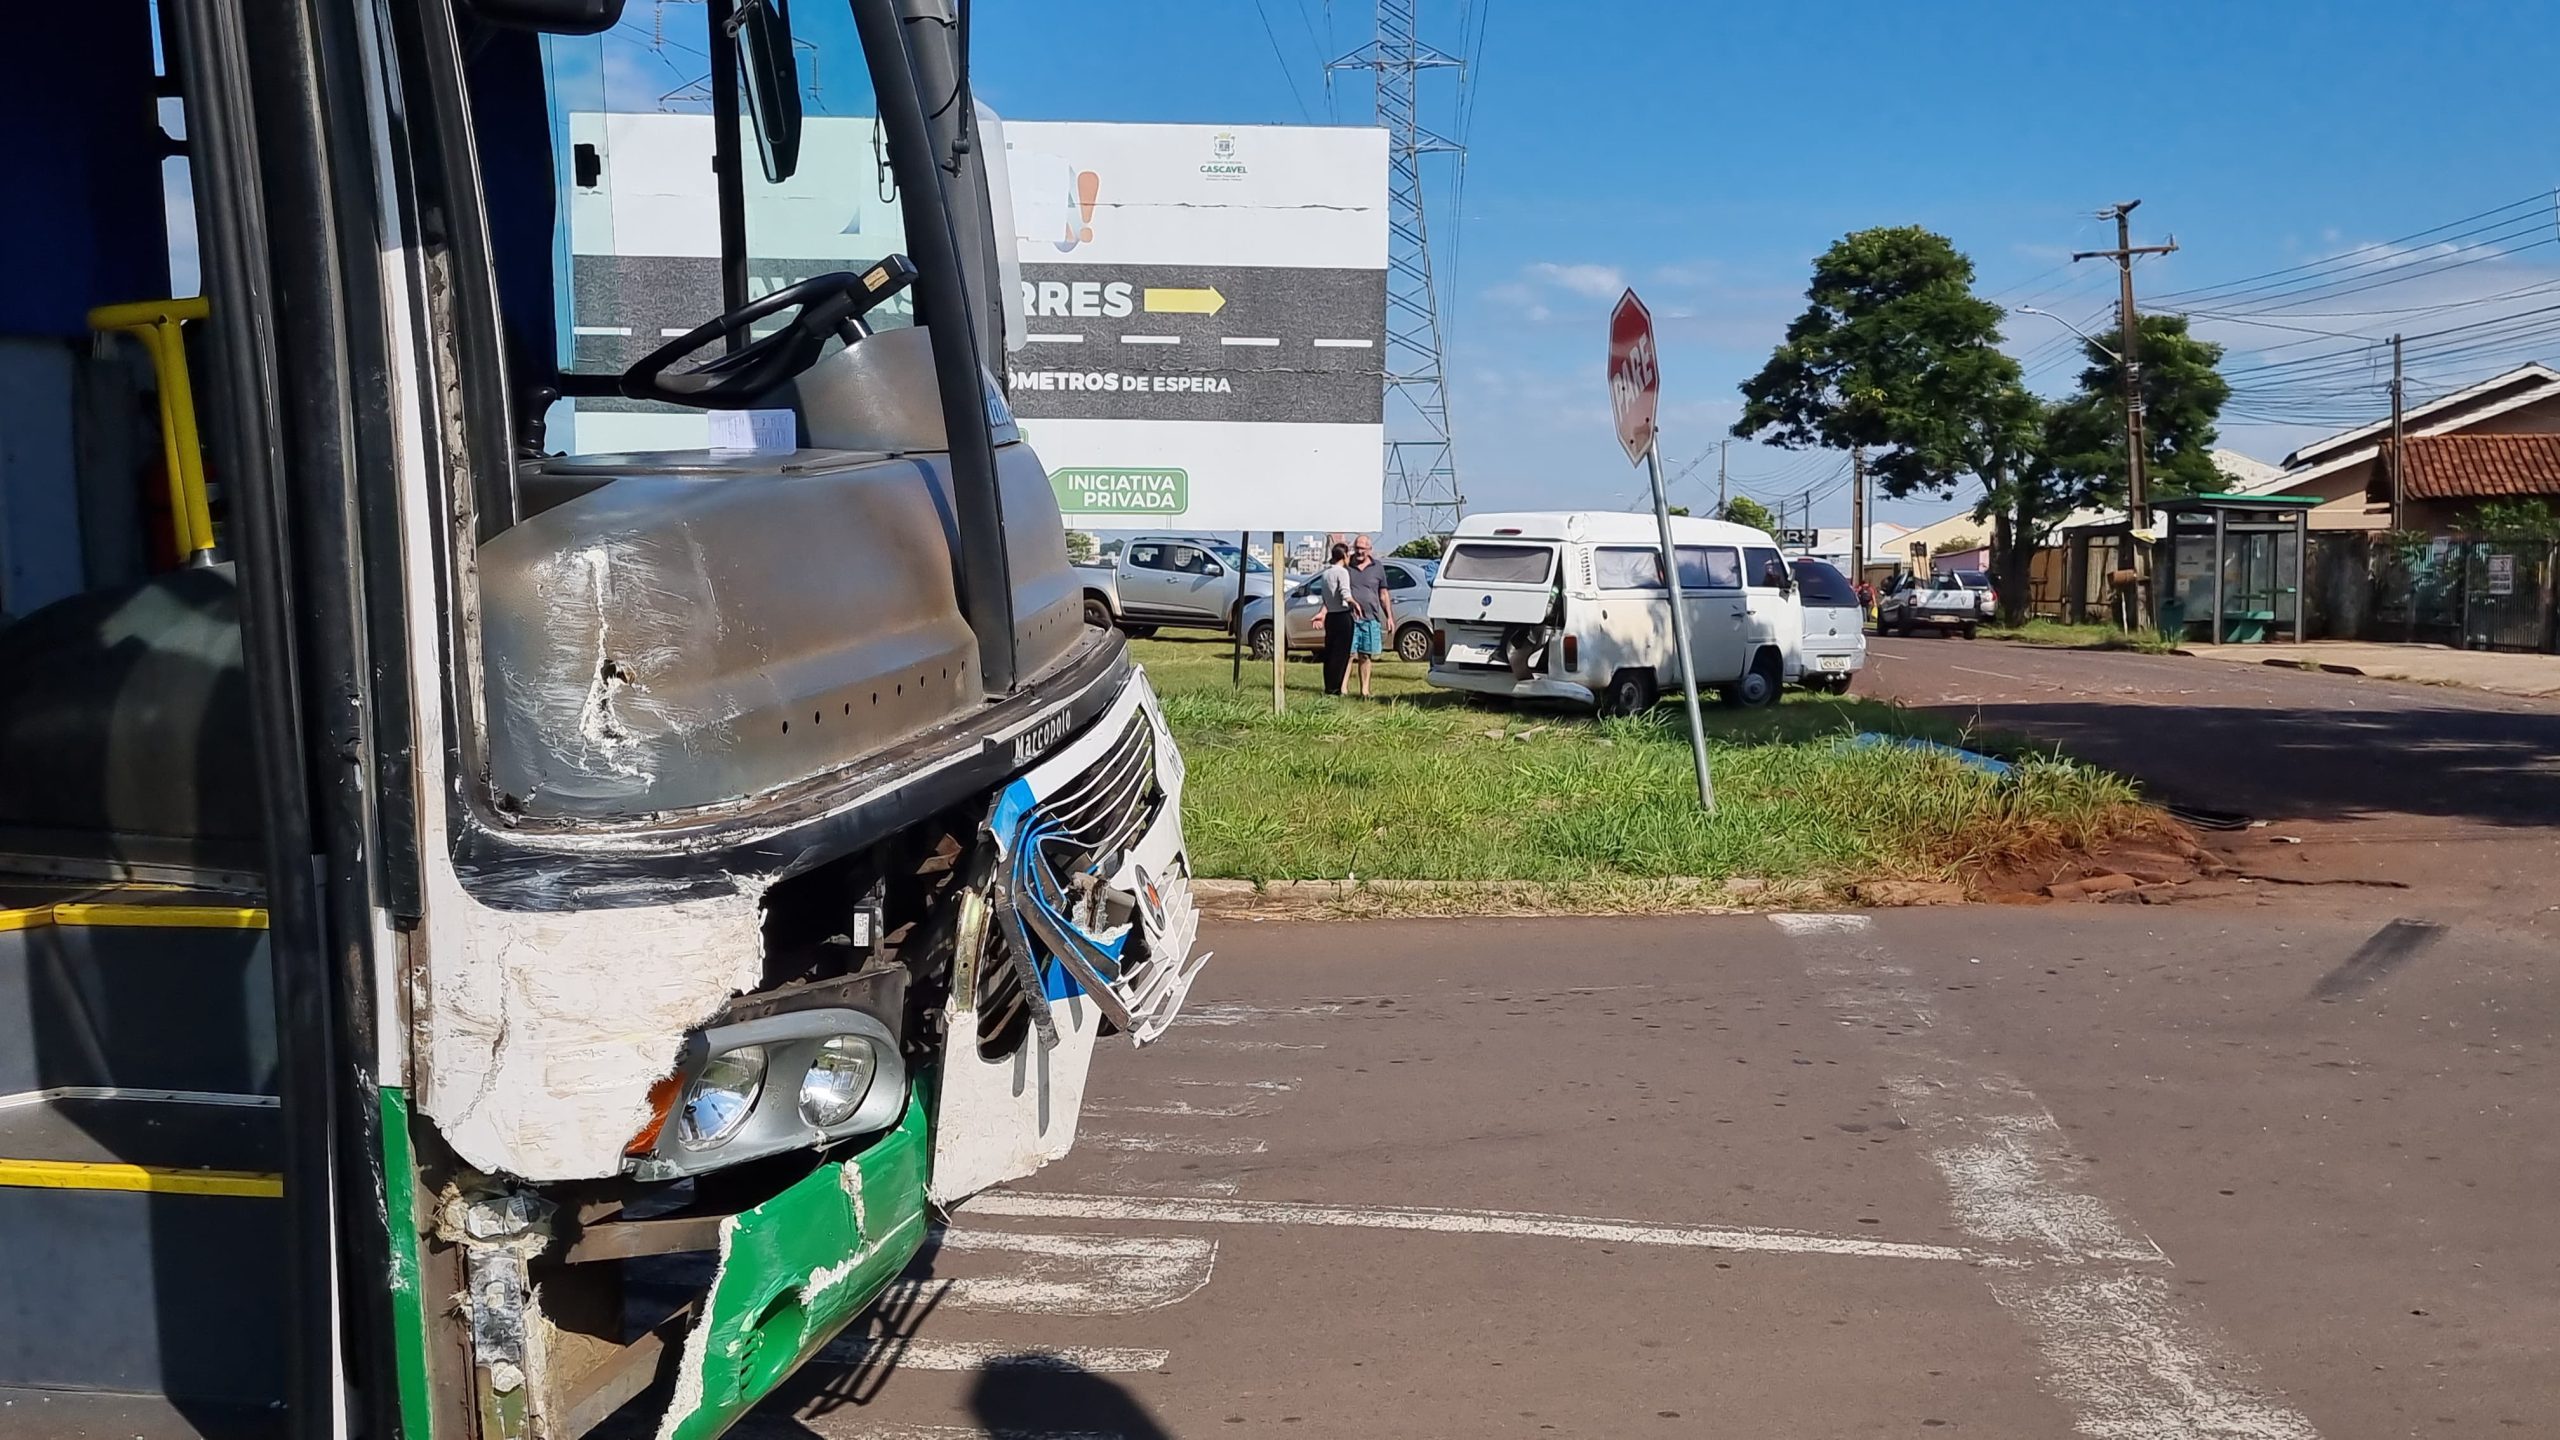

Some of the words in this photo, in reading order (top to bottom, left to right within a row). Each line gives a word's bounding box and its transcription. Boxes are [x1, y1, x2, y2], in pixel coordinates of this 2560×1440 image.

[1200, 165, 1247, 173] CASCAVEL
[1122, 377, 1149, 391] DE
[1153, 376, 1231, 393] ESPERA
[1613, 331, 1654, 423] PARE
[1068, 474, 1176, 491] INICIATIVA
[1083, 491, 1176, 508] PRIVADA
[1015, 709, 1071, 759] Marcopolo
